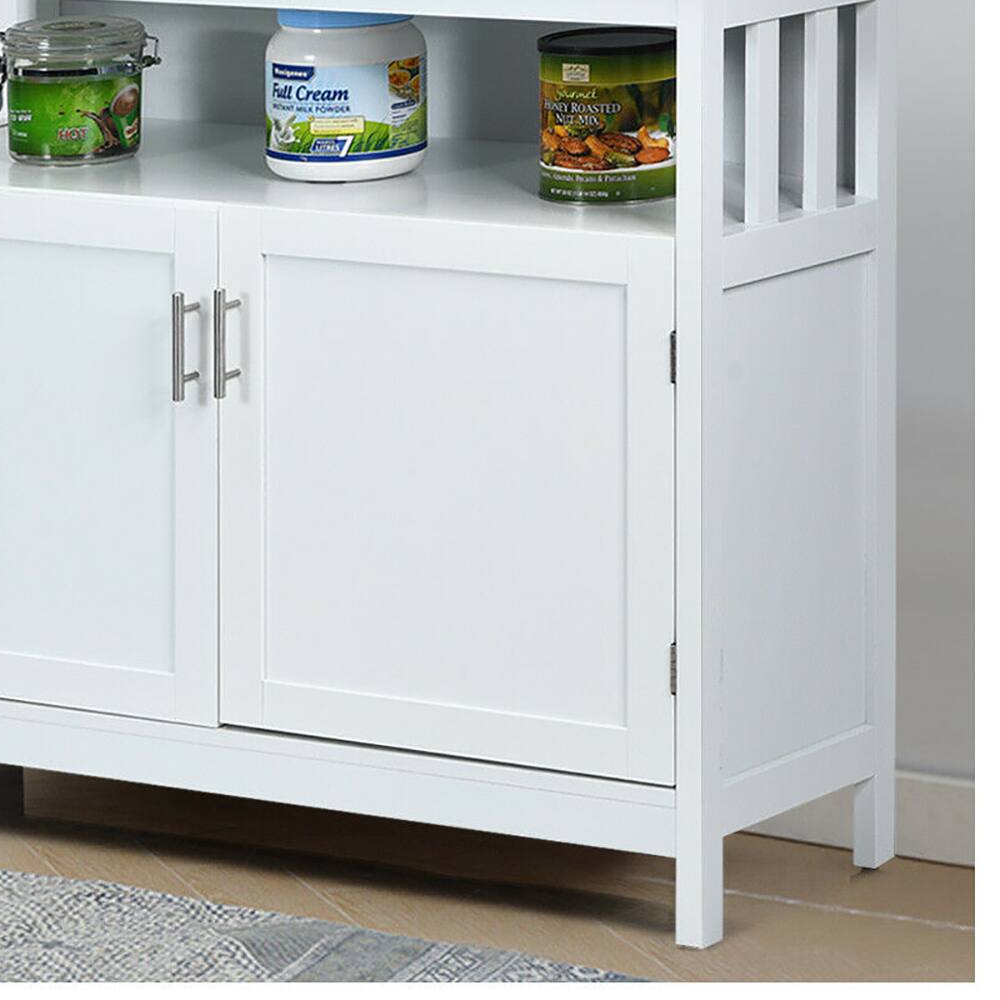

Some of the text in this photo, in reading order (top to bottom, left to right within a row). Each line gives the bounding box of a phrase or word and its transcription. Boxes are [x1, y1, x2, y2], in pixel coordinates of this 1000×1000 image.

[272, 82, 349, 102] Full Cream
[315, 105, 350, 113] POWDER
[571, 102, 622, 114] ROASTED
[556, 113, 600, 126] NUT MIX
[57, 127, 89, 140] HOT
[337, 135, 354, 158] 7
